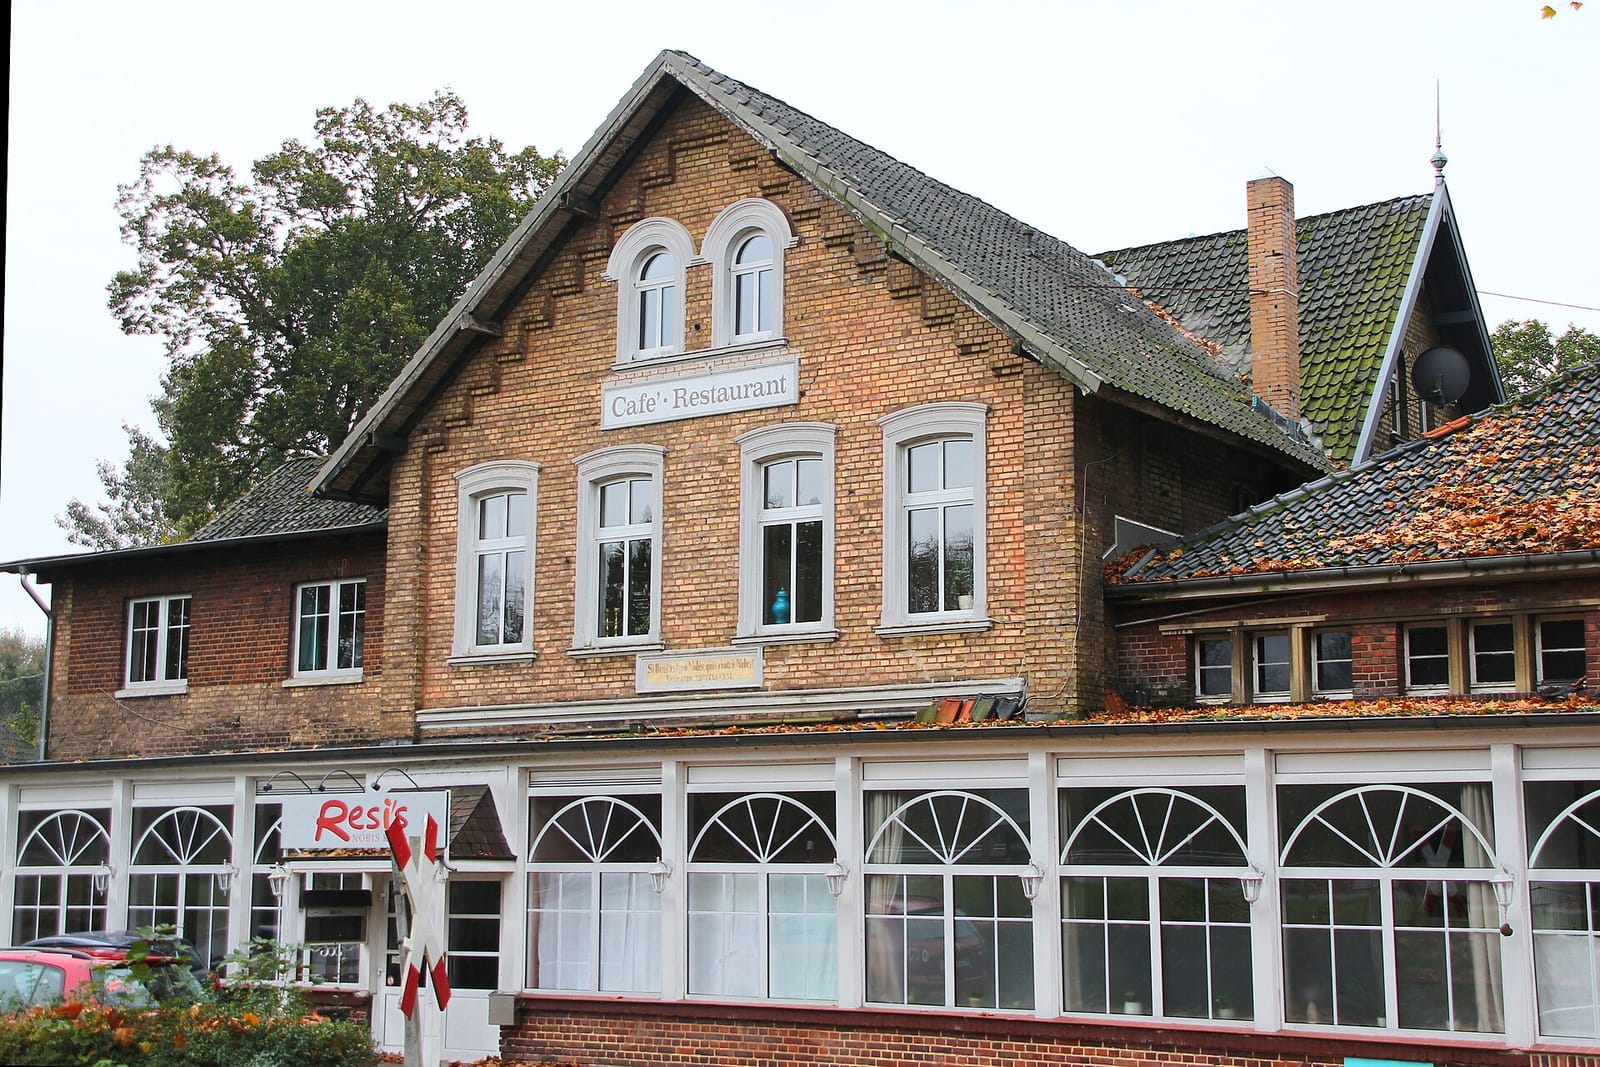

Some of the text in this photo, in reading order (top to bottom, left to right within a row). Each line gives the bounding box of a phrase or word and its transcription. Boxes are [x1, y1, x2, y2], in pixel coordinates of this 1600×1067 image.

[672, 375, 787, 409] Restaurant
[314, 798, 409, 842] Resi's
[352, 833, 380, 843] NOBIS
